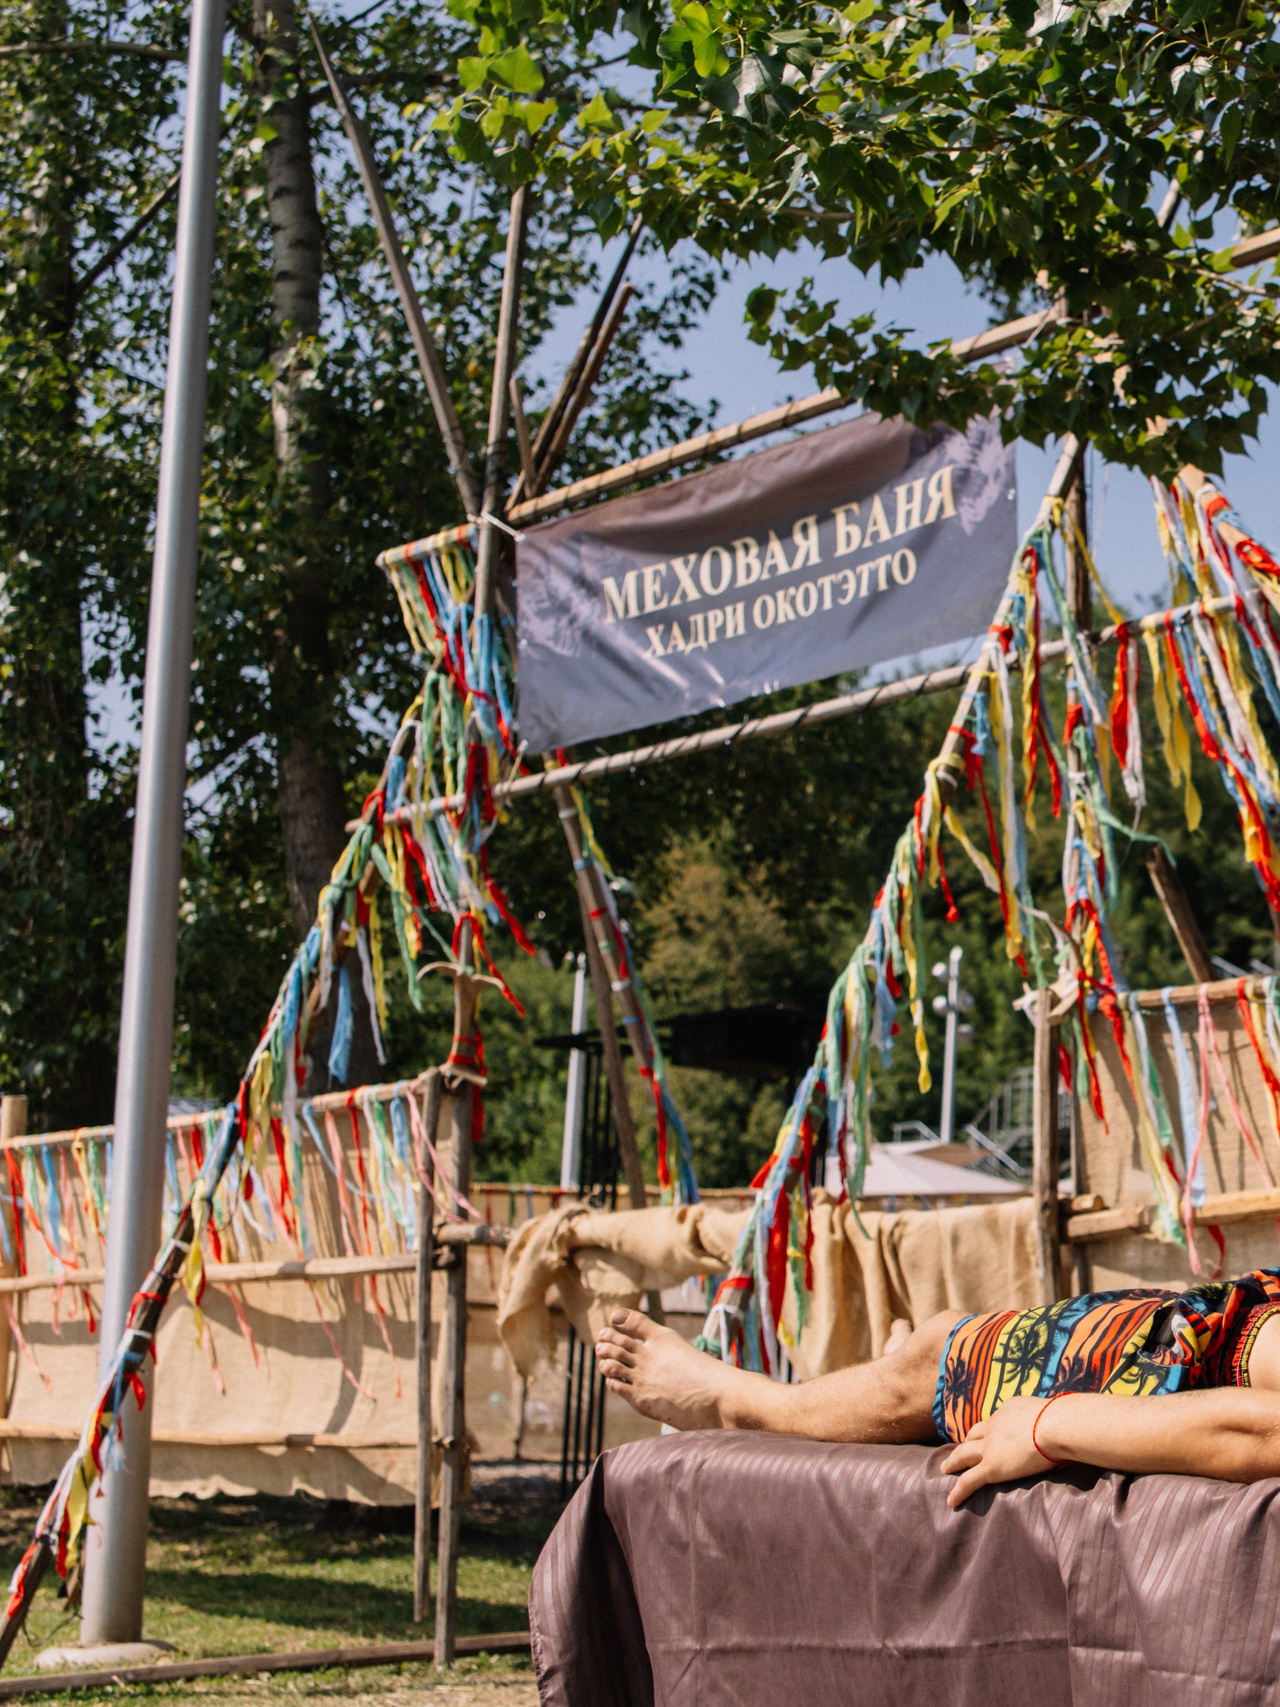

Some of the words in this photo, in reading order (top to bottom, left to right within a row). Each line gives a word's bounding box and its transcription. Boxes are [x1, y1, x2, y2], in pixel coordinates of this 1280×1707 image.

[602, 514, 822, 625] МЕХОВАЯ
[832, 464, 958, 558] БАНЯ
[644, 601, 746, 659] ХАДРИ
[752, 547, 918, 629] ОКОТЭТТО
